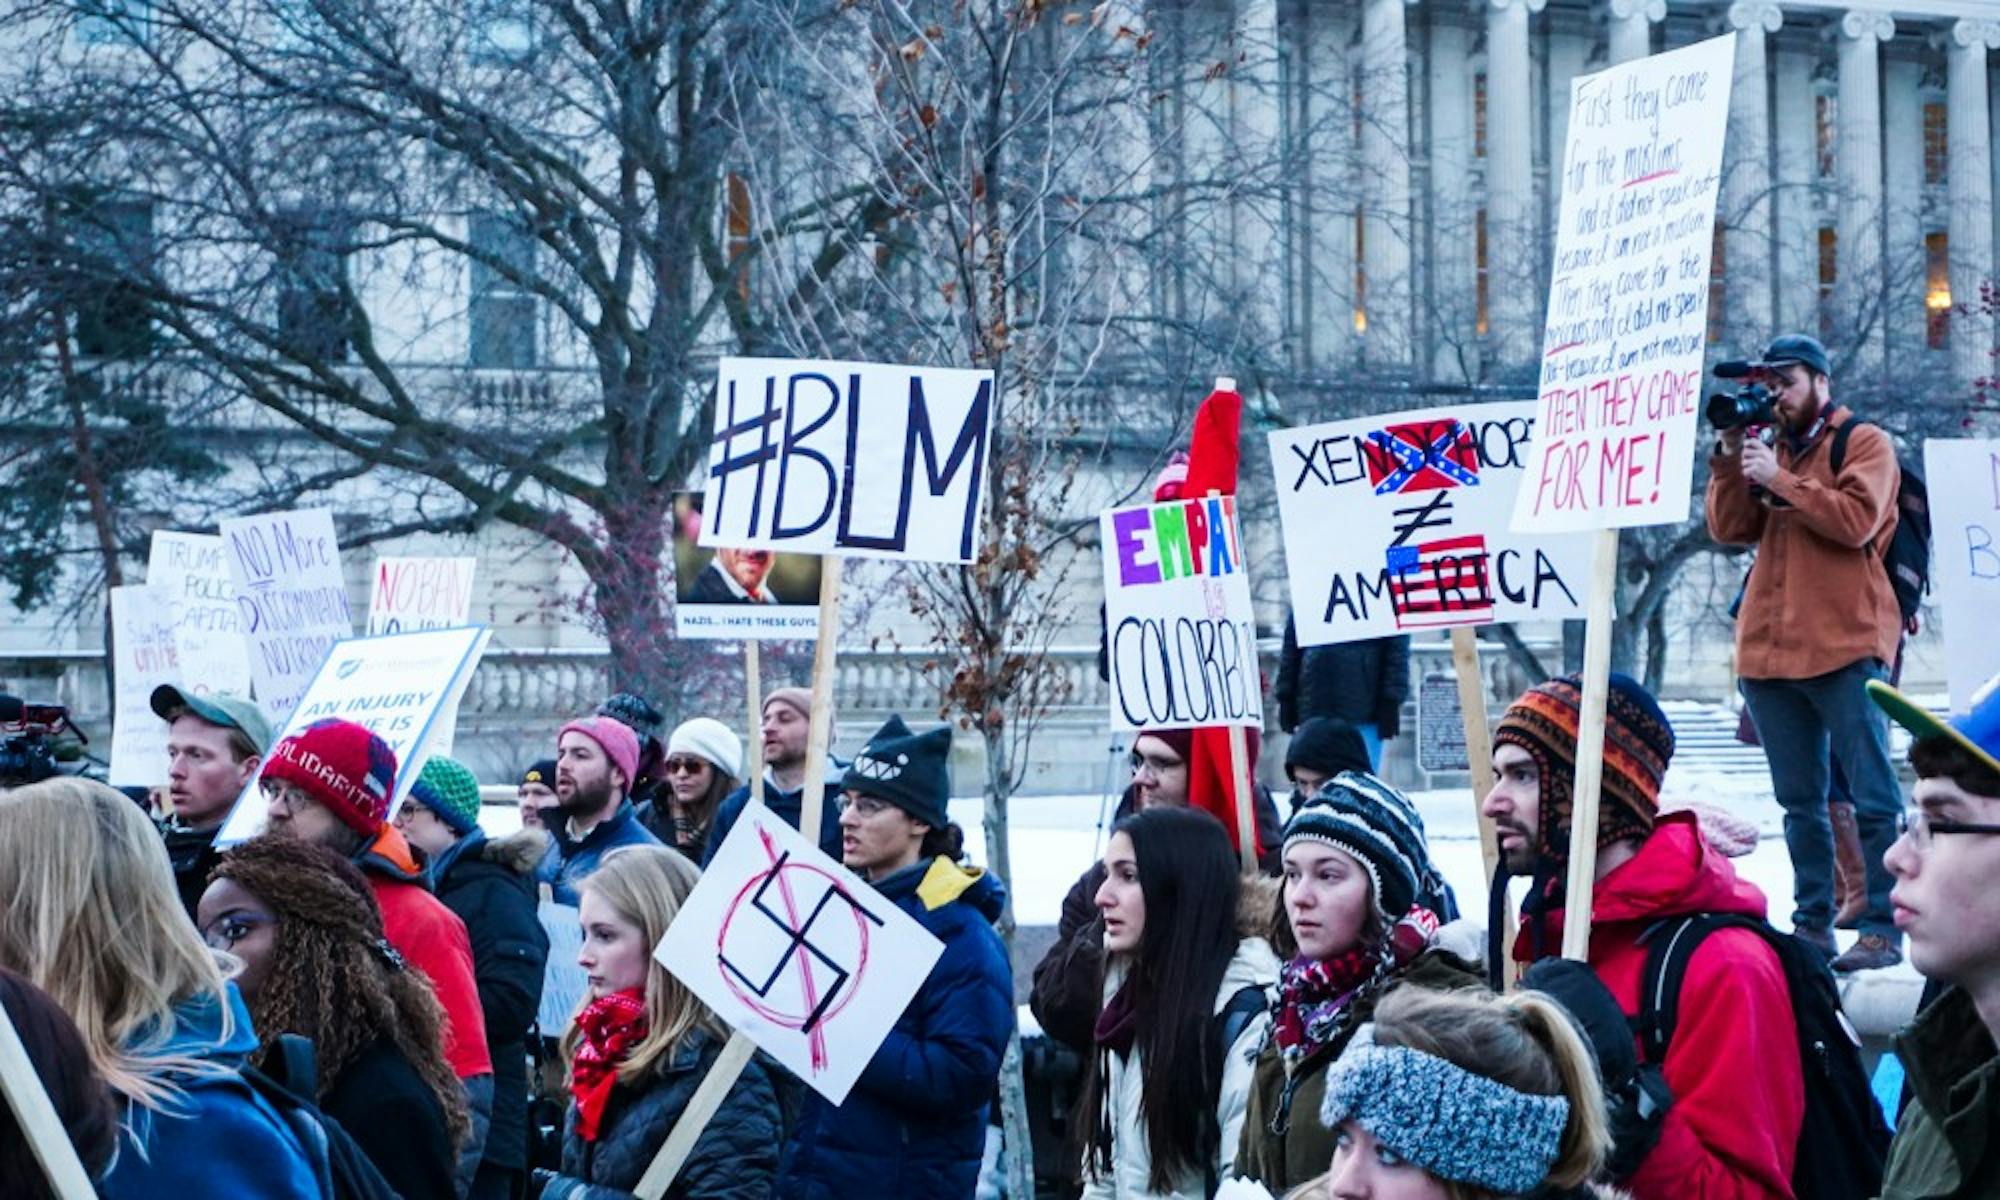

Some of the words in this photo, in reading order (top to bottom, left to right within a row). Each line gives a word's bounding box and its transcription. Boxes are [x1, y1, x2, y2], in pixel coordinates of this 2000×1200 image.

[1574, 79, 1613, 127] First
[1624, 74, 1660, 138] they
[1665, 71, 1708, 109] came
[1567, 139, 1588, 195] for
[1597, 146, 1617, 184] the
[1576, 199, 1598, 236] and
[1615, 190, 1638, 226] did
[1659, 175, 1693, 221] speak
[1554, 276, 1583, 318] Then
[1588, 276, 1613, 314] they
[1617, 267, 1648, 297] came
[1652, 255, 1670, 292] for
[1680, 247, 1702, 280] the
[1634, 300, 1653, 331] did
[1674, 282, 1706, 328] speak
[1541, 385, 1588, 438] THEN
[1590, 375, 1645, 428] THEY
[1648, 369, 1699, 420] CAME
[710, 372, 993, 561] #BLM
[1534, 440, 1590, 517] FOR
[1598, 431, 1665, 508] ME!
[231, 526, 273, 581] NO
[271, 520, 330, 575] More
[375, 561, 417, 613] NO
[417, 559, 473, 618] BAN
[1323, 548, 1578, 623] AMERICA
[727, 617, 752, 627] HATE
[756, 617, 786, 627] THESE
[303, 701, 341, 716] AN
[345, 692, 433, 712] INJURY
[390, 715, 414, 731] IS
